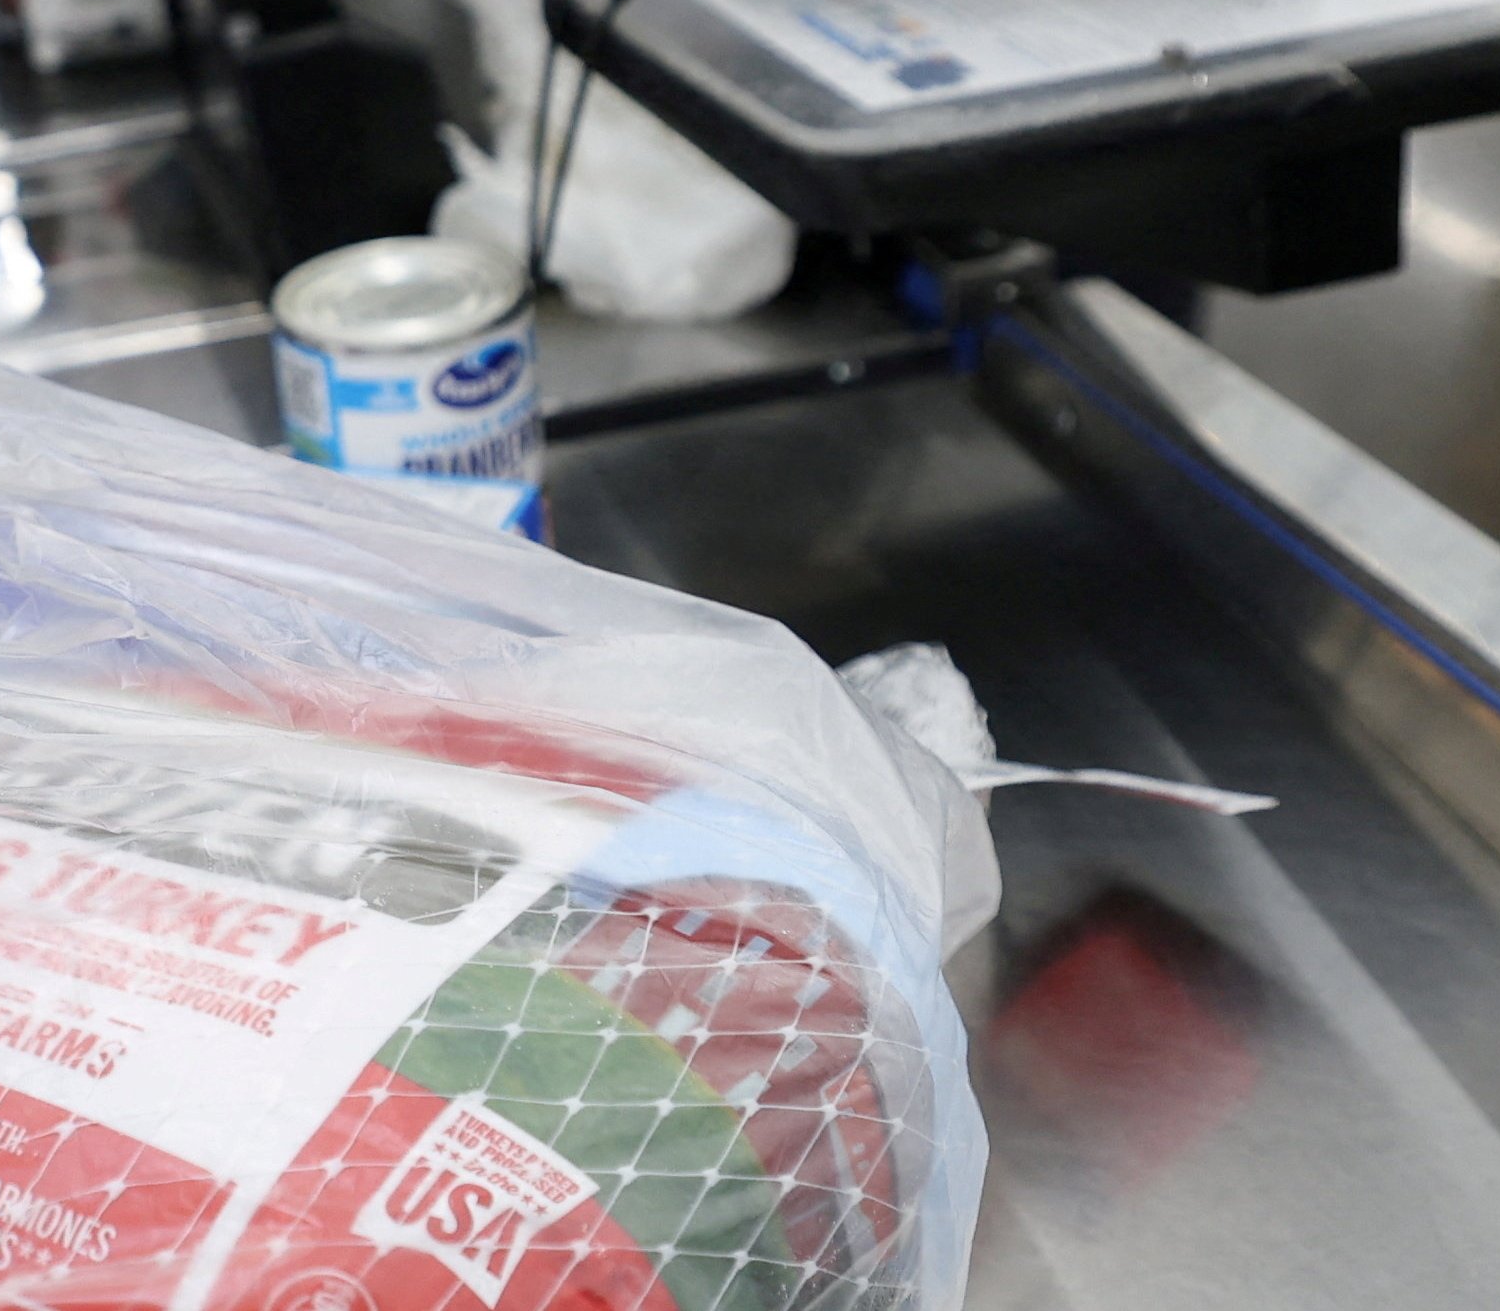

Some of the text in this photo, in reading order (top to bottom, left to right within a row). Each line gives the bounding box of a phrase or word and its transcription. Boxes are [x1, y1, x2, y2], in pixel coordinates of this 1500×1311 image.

[31, 852, 357, 967] TURKEY
[134, 976, 276, 1038] AVORING.
[255, 979, 300, 1006] OF
[443, 1124, 481, 1150] AND
[455, 1109, 529, 1159] TURKEYS
[462, 1158, 520, 1196] in the
[385, 1155, 526, 1281] USA
